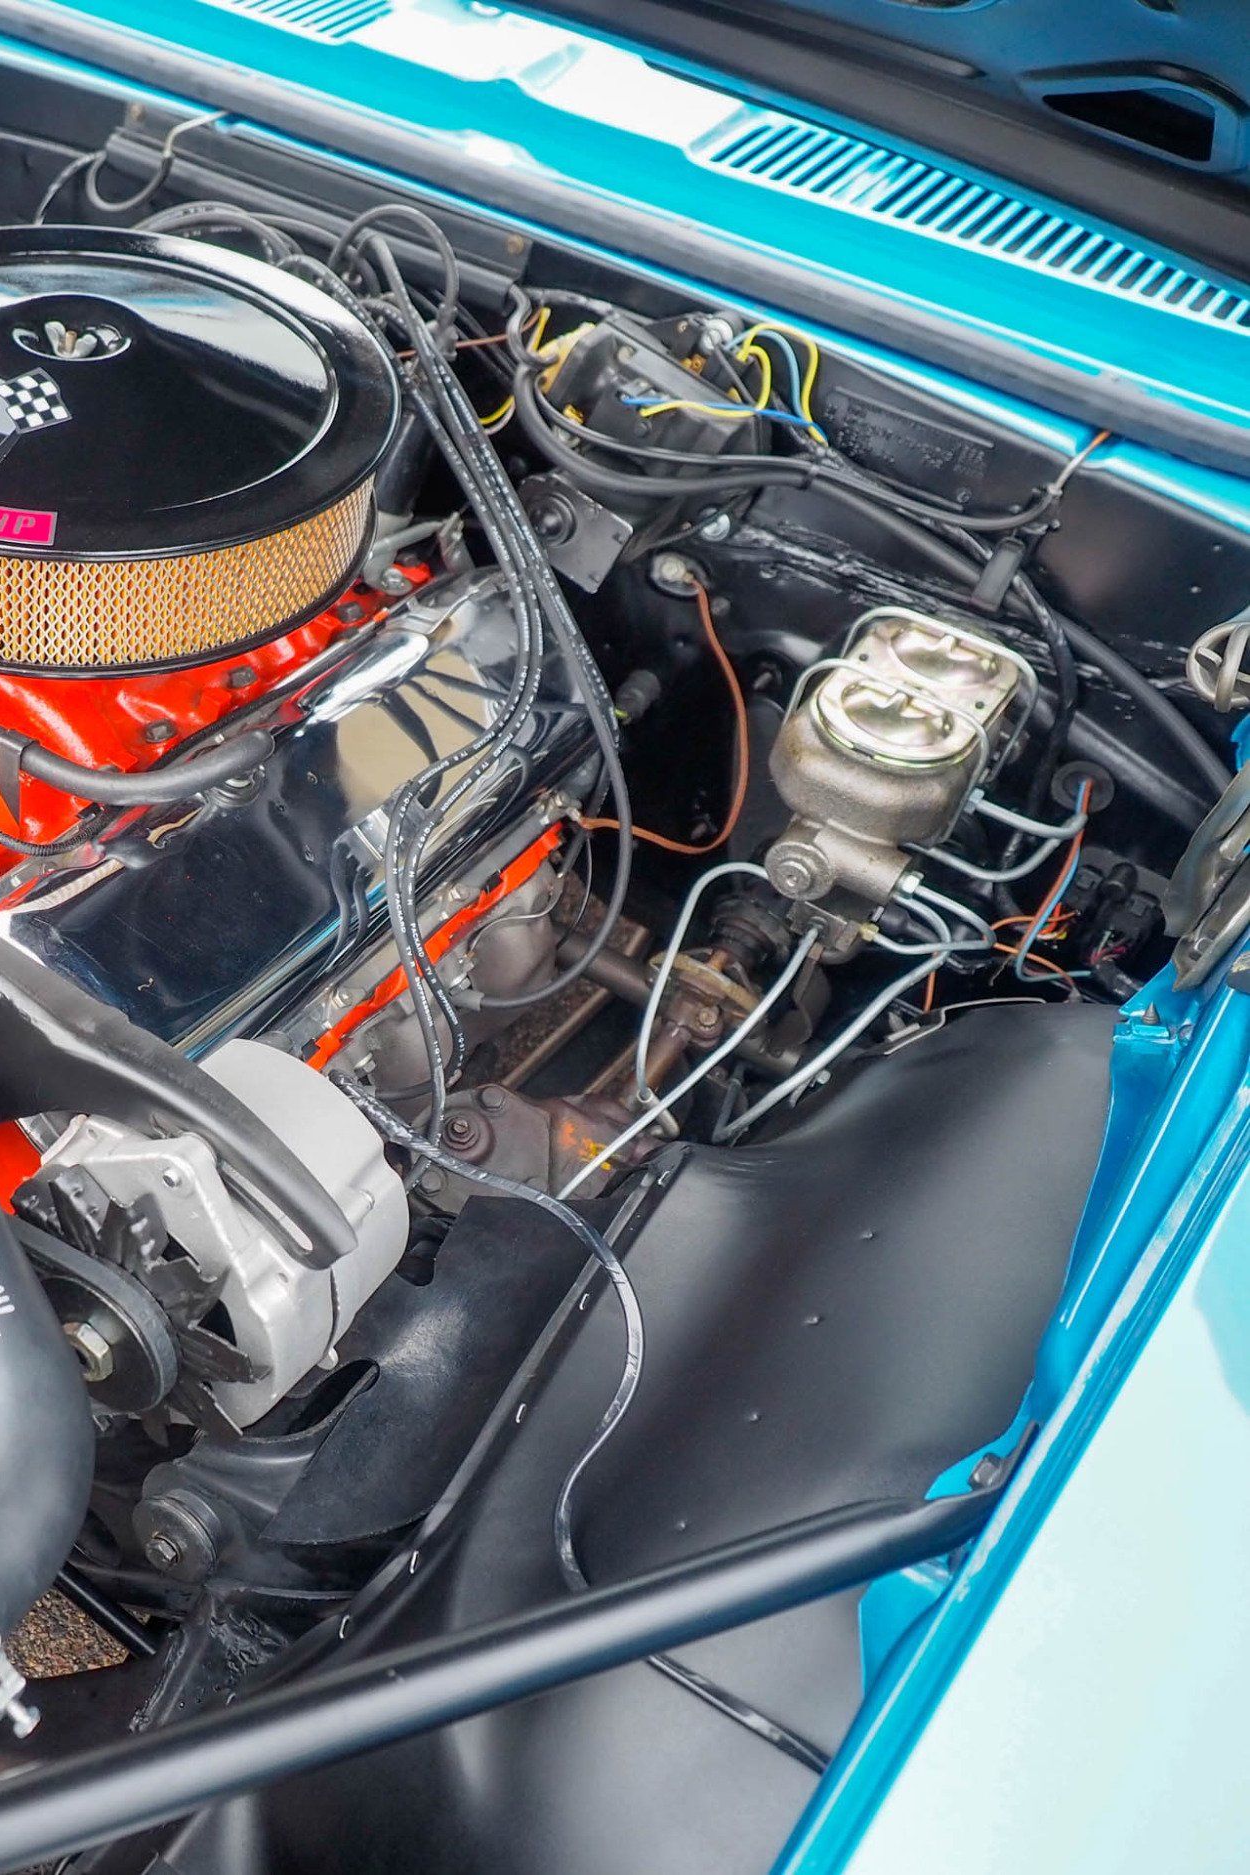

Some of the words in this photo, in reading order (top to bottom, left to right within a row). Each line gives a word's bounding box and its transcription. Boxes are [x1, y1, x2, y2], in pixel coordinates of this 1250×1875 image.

[395, 893, 407, 933] PACKARD
[415, 976, 433, 1027] SUPPRESSION
[411, 923, 425, 958] PACKARD
